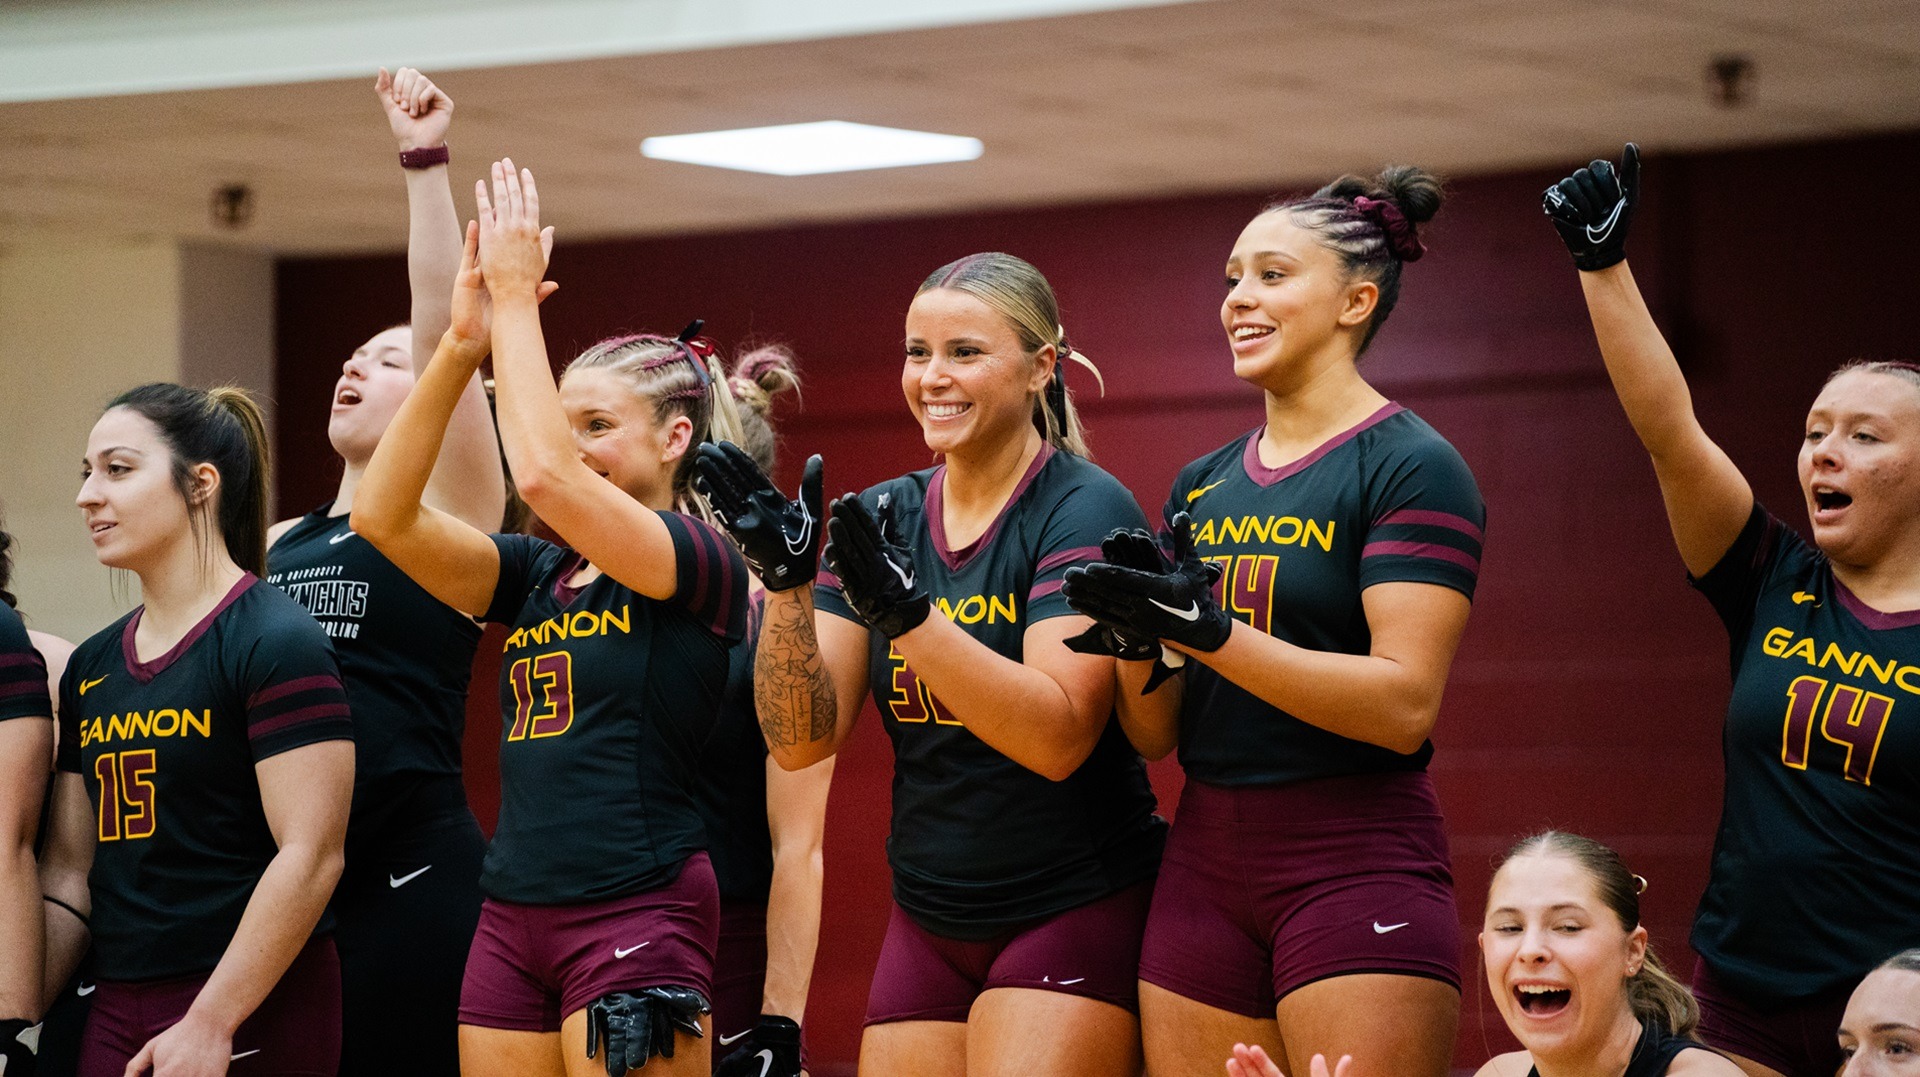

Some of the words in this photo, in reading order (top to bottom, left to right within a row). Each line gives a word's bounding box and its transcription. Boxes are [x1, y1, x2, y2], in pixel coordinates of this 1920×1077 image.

[1190, 515, 1336, 552] ANNON
[936, 593, 1017, 624] NON
[507, 650, 574, 742] 13
[1781, 675, 1896, 787] 14
[95, 749, 156, 841] 15
